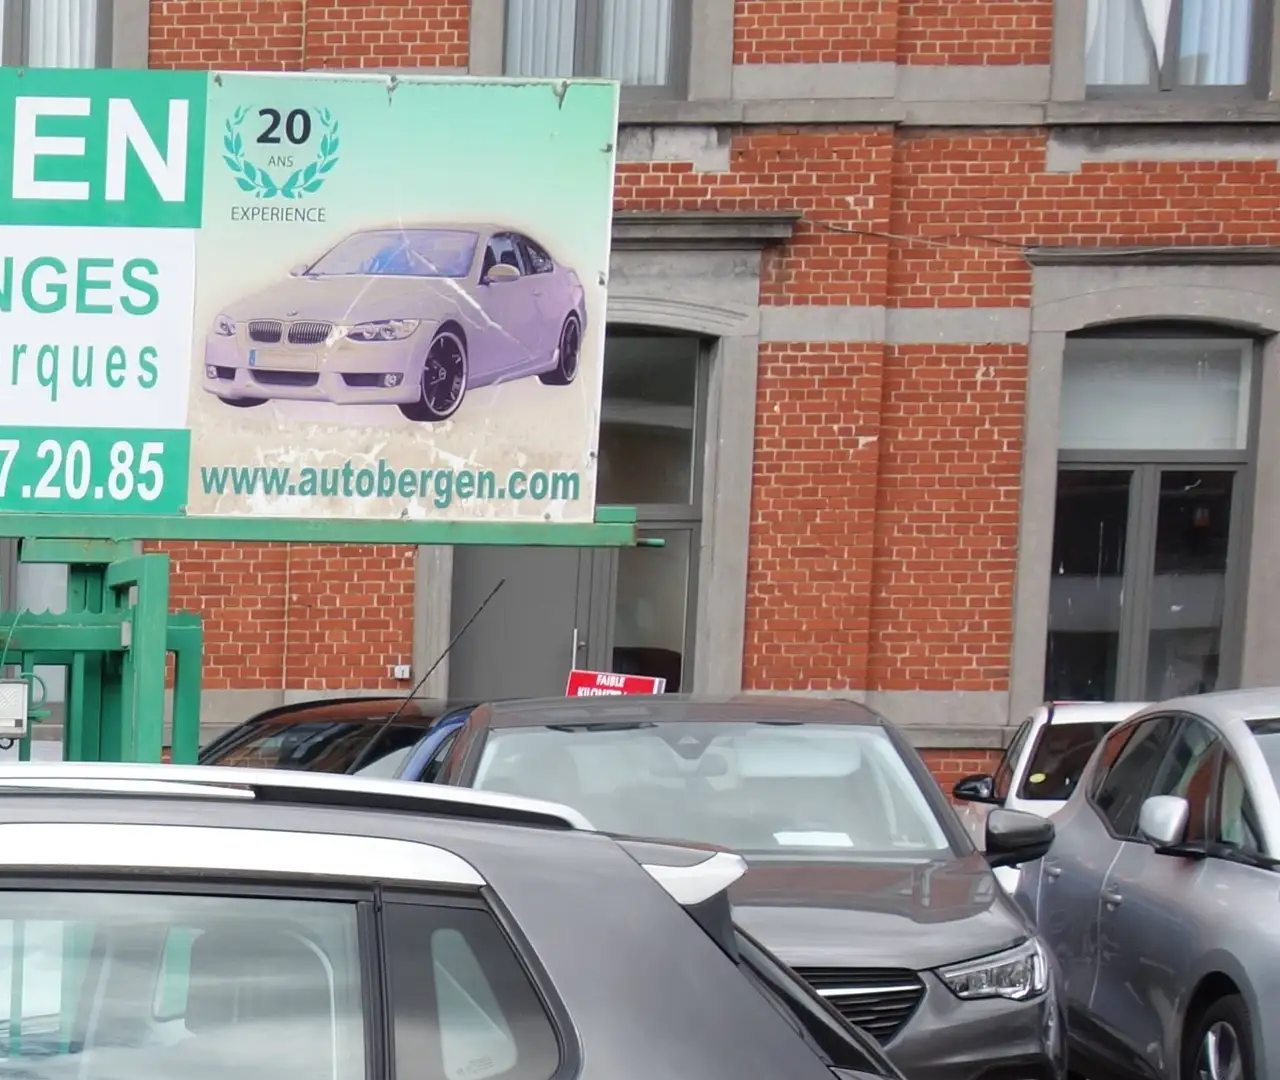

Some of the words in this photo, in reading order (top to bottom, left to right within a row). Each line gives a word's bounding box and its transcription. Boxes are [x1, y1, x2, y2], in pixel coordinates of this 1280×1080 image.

[256, 108, 312, 145] 20
[268, 155, 294, 168] ANS
[230, 206, 326, 223] EXPERIENCE
[200, 459, 580, 508] www.autobergen.com
